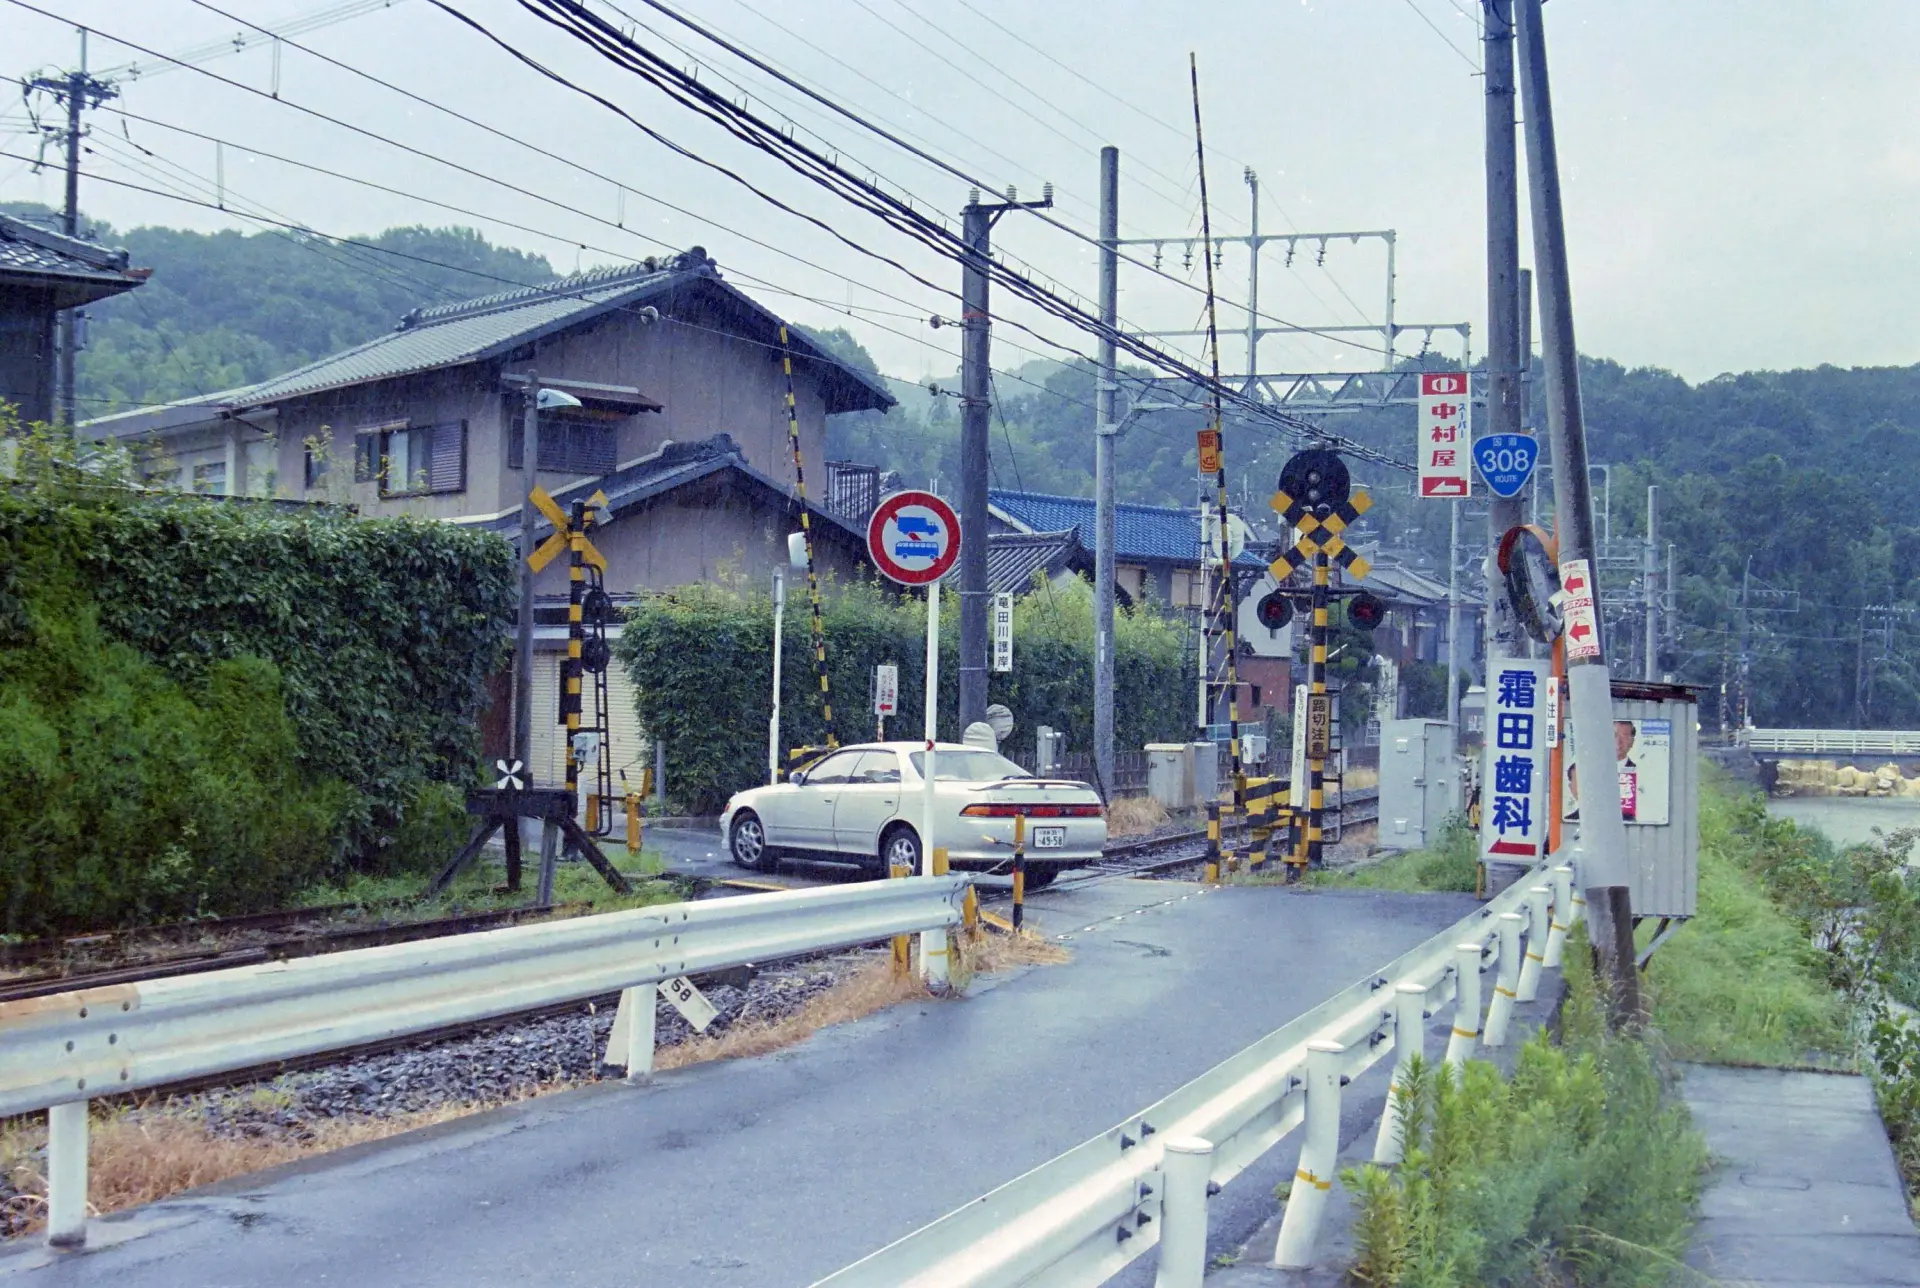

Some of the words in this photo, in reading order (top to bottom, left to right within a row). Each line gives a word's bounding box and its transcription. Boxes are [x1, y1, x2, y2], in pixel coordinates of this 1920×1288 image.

[1431, 402, 1457, 467] 中村屋
[1458, 403, 1467, 438] スーパー
[1482, 449, 1530, 473] 308
[1494, 475, 1518, 483] ROUTE
[997, 596, 1009, 668] 竜田川護岸
[1311, 698, 1326, 753] 踏切注意
[1546, 701, 1556, 742] 注意
[1492, 669, 1537, 837] 霜田歯科
[671, 978, 692, 1002] 58
